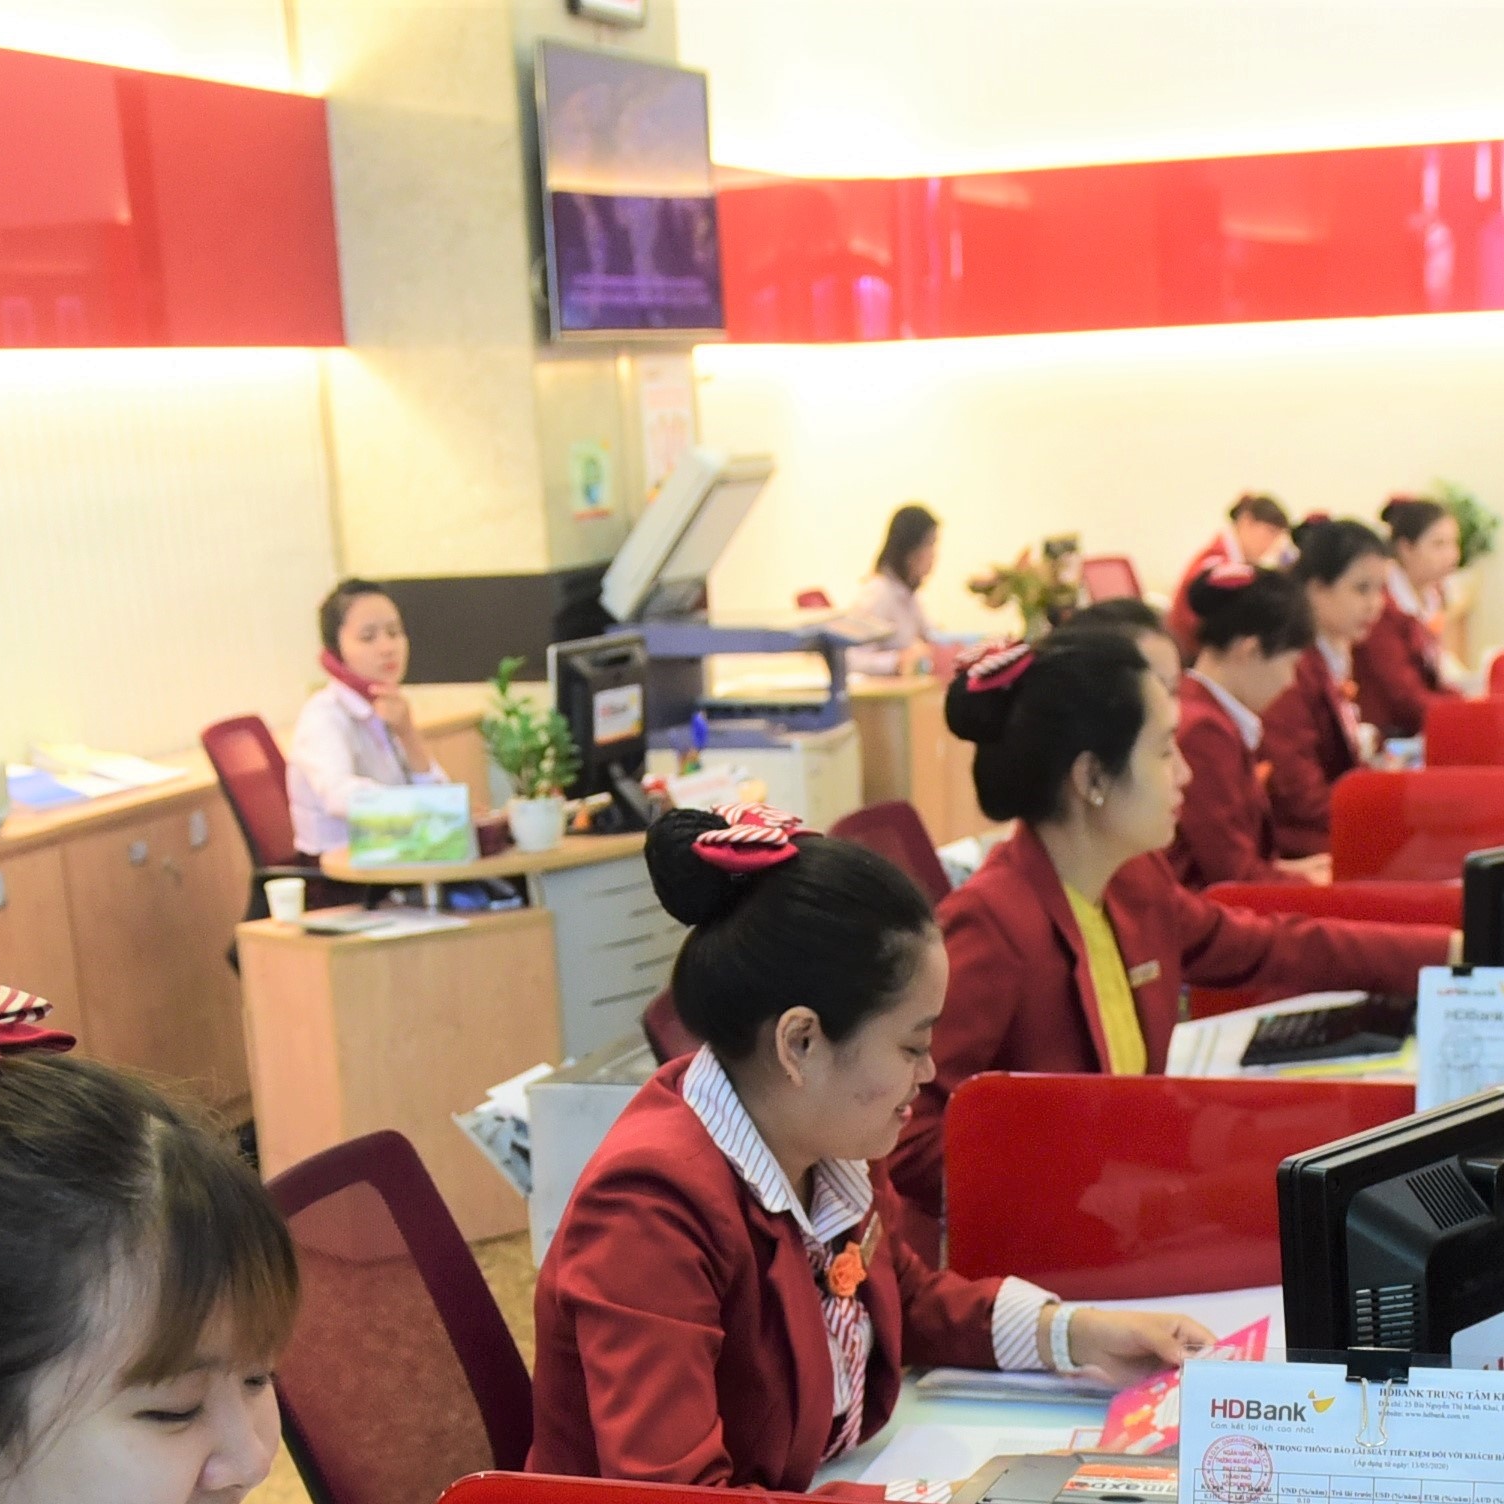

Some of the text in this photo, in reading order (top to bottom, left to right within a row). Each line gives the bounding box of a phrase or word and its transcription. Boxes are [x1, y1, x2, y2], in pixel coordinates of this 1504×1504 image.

[1379, 1388, 1424, 1399] HDBANK
[1427, 1390, 1464, 1400] TRUNG
[1466, 1389, 1491, 1400] TÂM
[1210, 1398, 1307, 1422] HDBank
[1210, 1422, 1228, 1431] Cam
[1231, 1421, 1245, 1431] kết
[1248, 1422, 1259, 1432] lợi
[1277, 1425, 1292, 1433] cao
[1296, 1424, 1315, 1434] nhất
[1275, 1444, 1302, 1454] TRỌNG
[1304, 1444, 1332, 1454] THÔNG
[1464, 1452, 1494, 1461] KHÁCH
